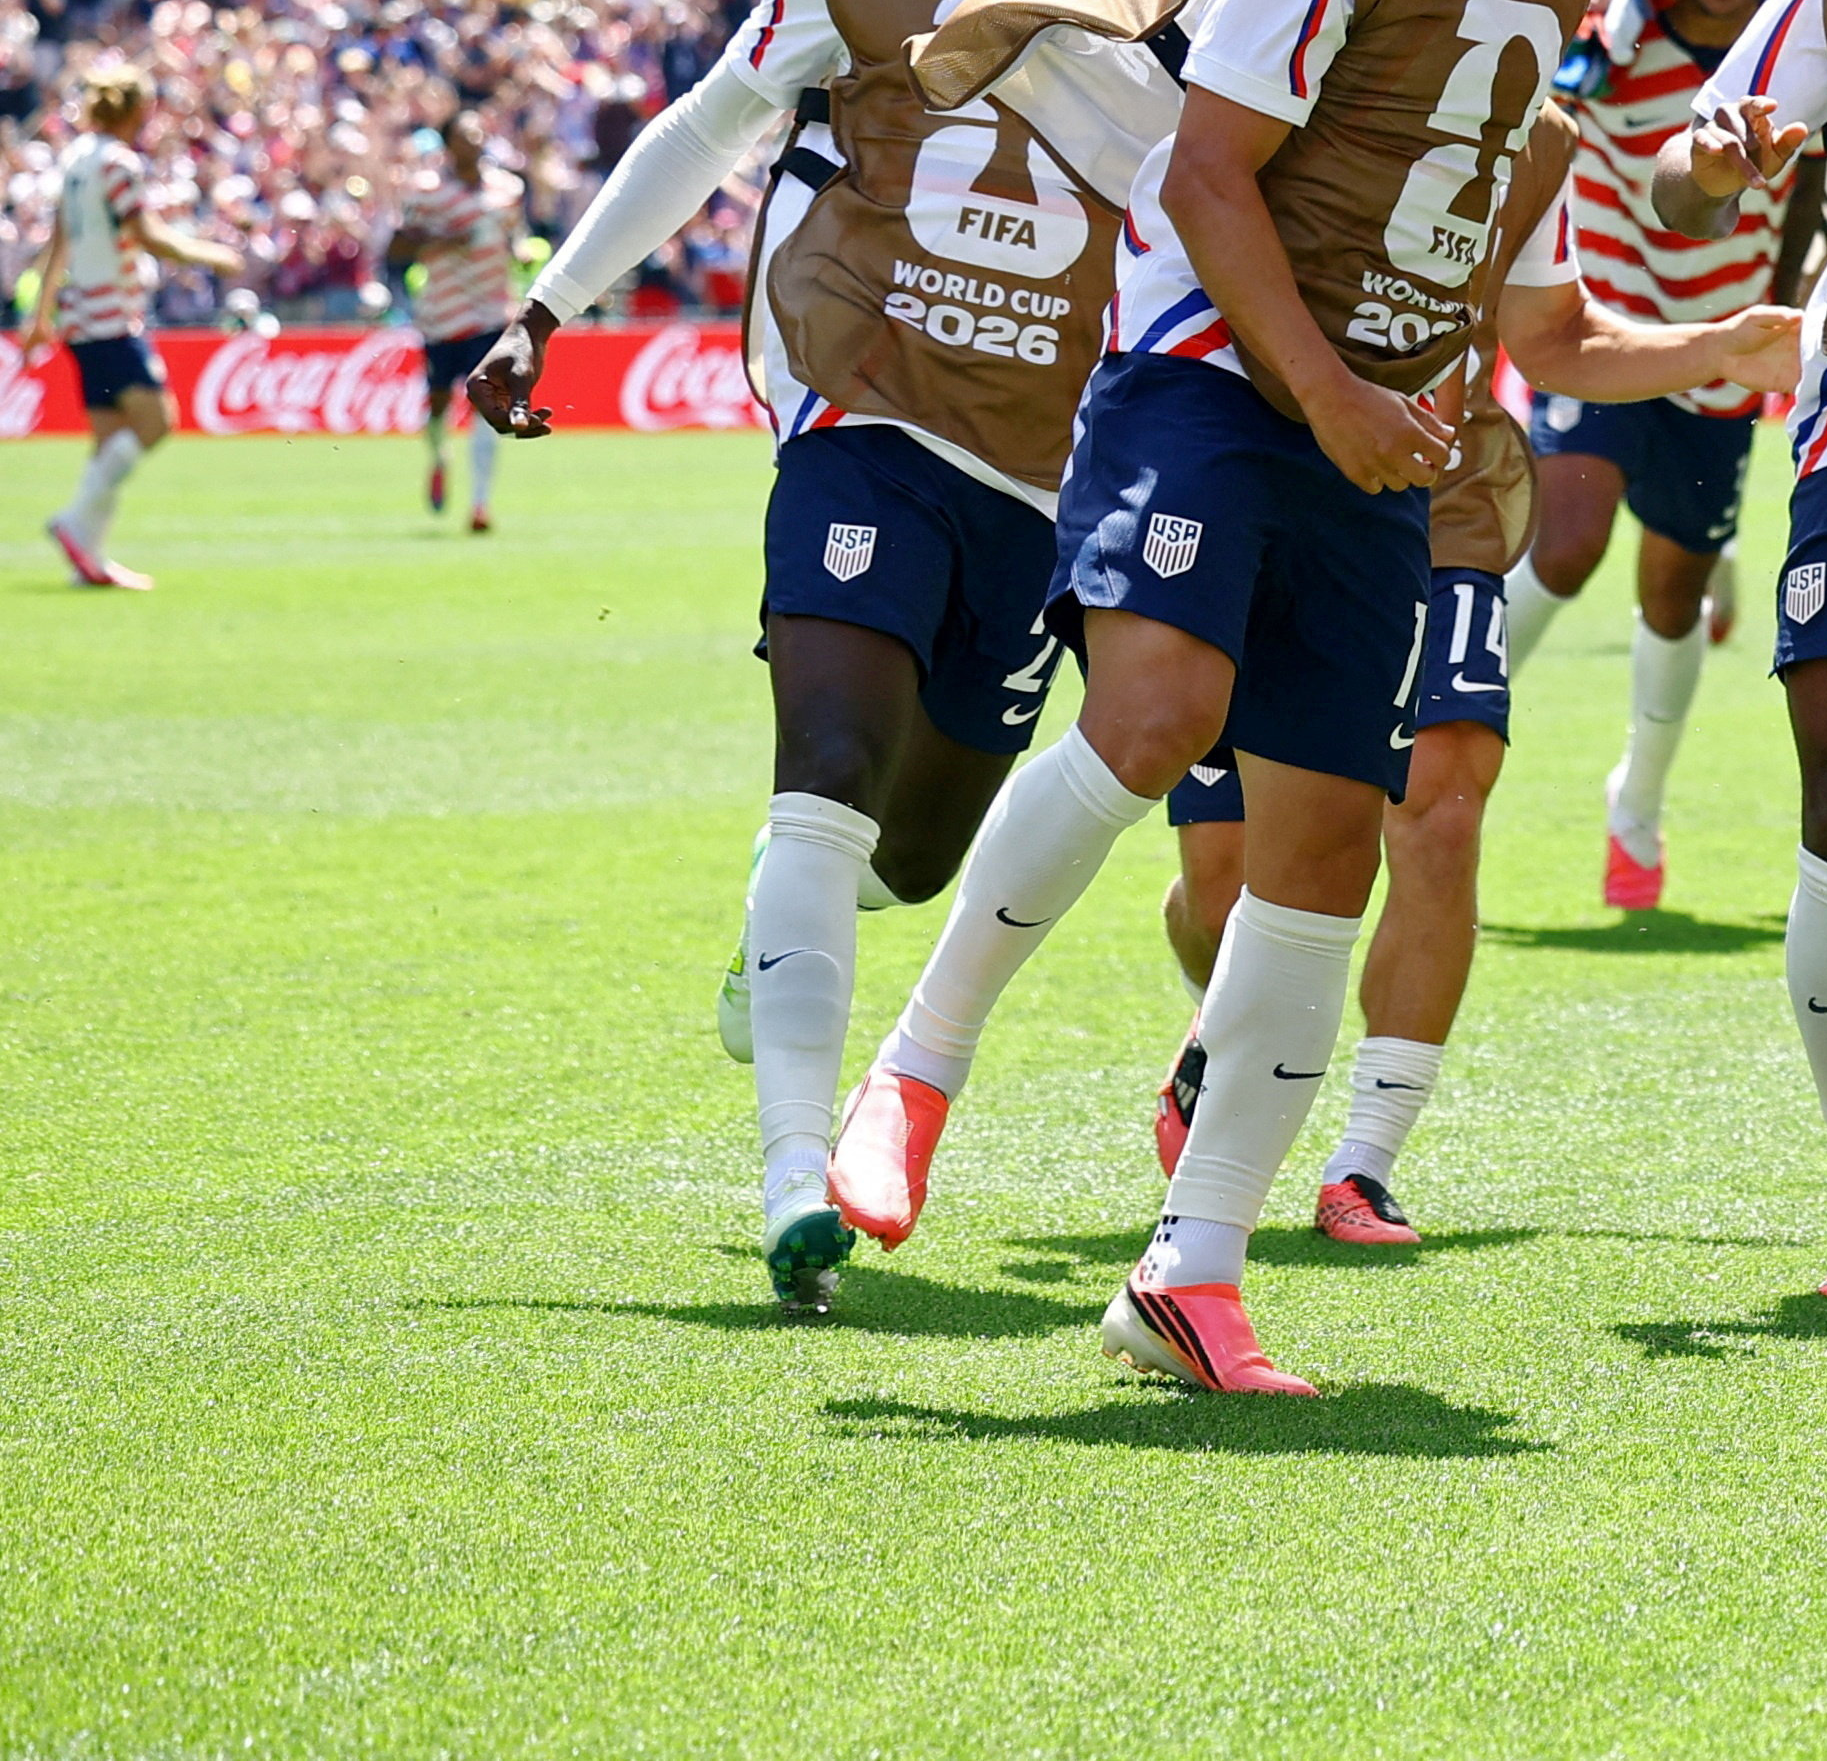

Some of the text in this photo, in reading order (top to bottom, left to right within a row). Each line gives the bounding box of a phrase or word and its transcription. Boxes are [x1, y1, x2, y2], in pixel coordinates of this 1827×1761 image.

[956, 206, 1038, 251] FIFA
[1427, 225, 1478, 267] FIFA
[893, 259, 1072, 320] WORLD CUP
[884, 292, 1060, 366] 2026
[831, 526, 873, 550] USA
[1154, 514, 1199, 543] USA
[1790, 565, 1822, 591] USA
[1448, 583, 1509, 677] 14
